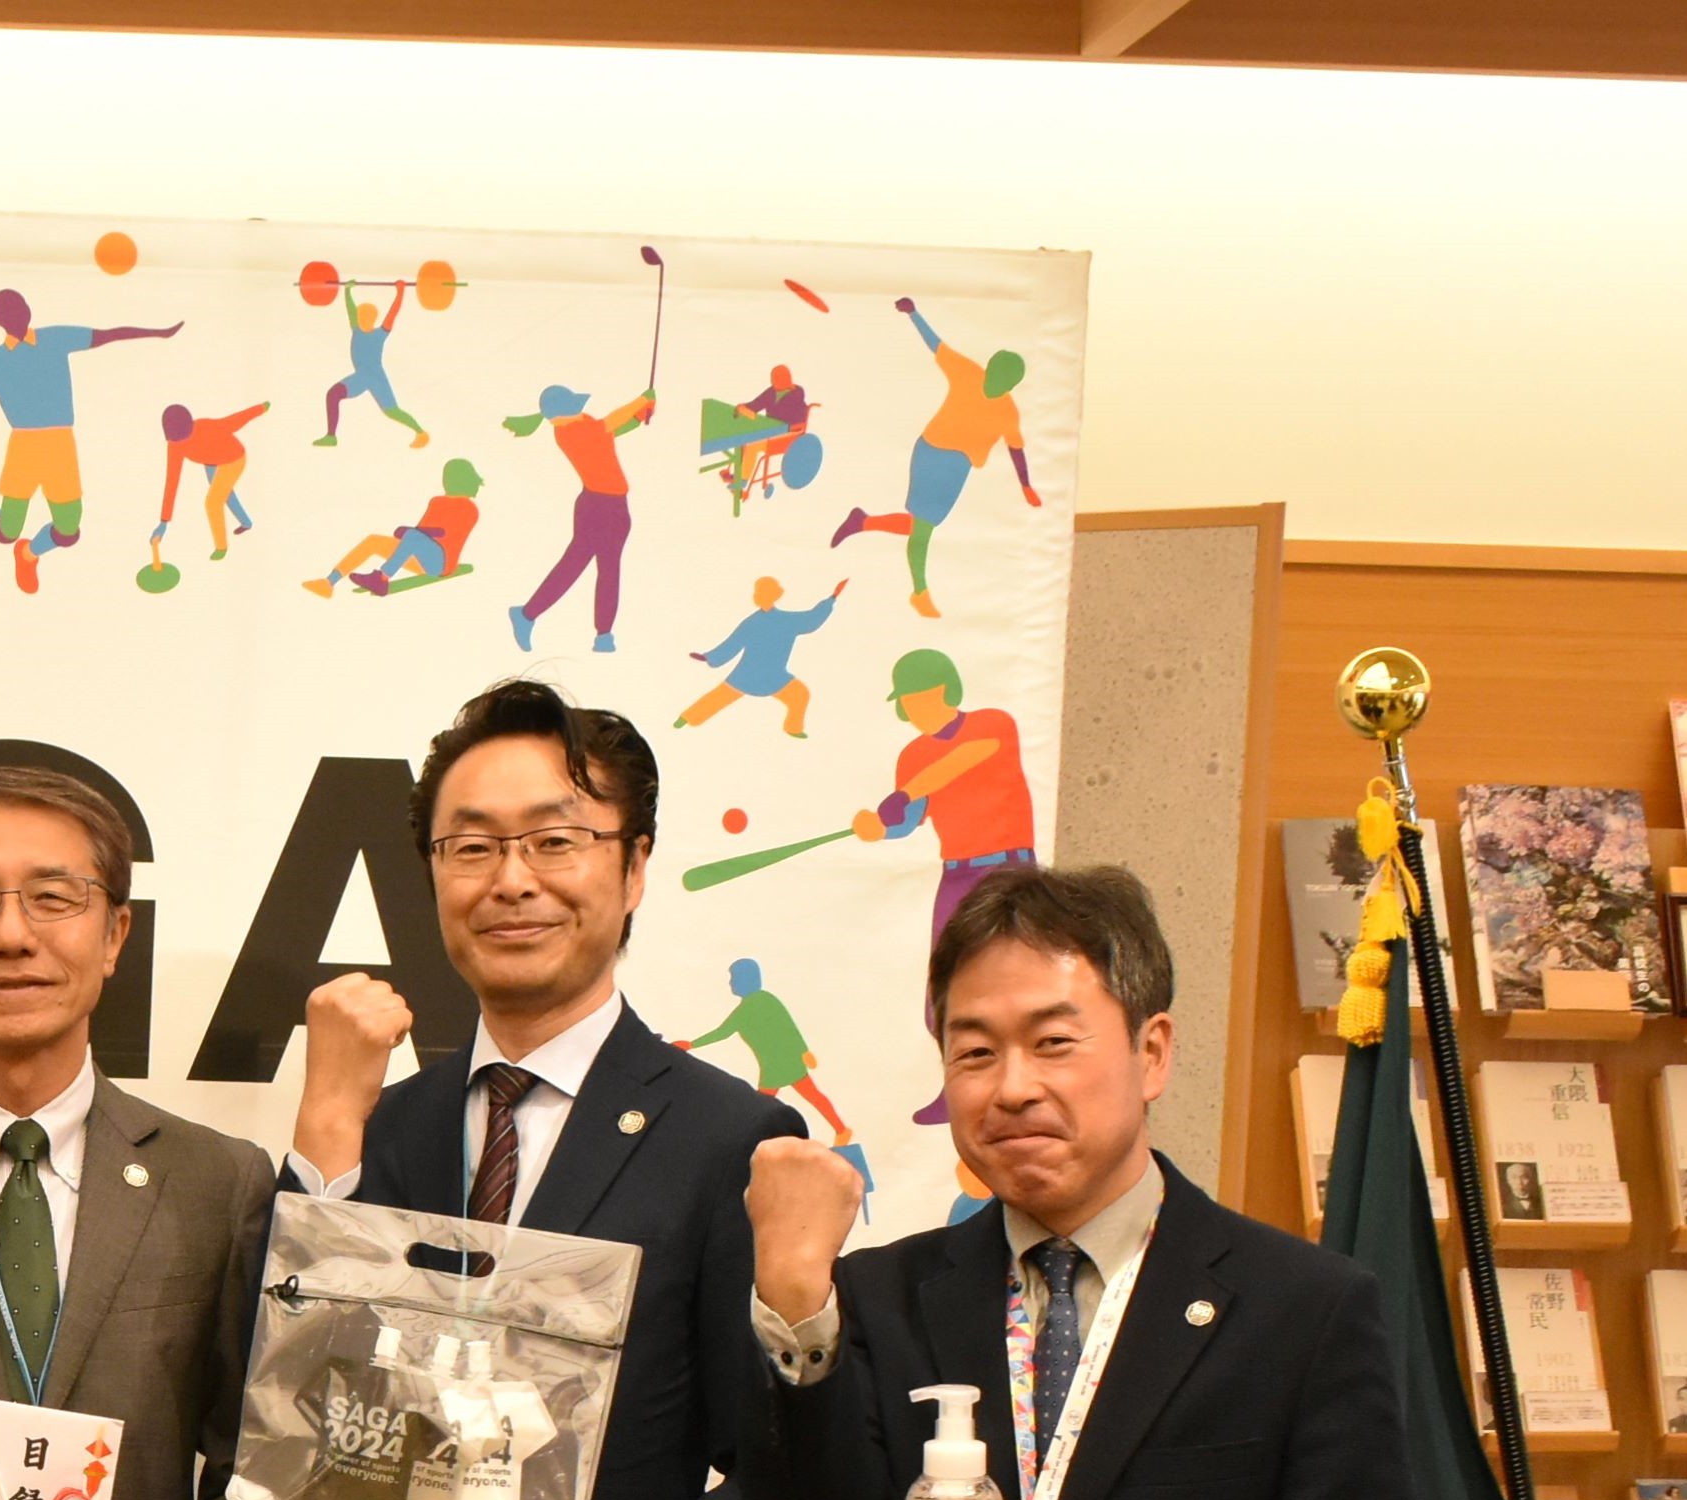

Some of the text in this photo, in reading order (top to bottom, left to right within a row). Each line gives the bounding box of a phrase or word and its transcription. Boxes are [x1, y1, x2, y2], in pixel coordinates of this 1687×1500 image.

[327, 1396, 408, 1437] SAGA
[325, 1419, 404, 1463] 2024
[412, 1475, 453, 1492] ryone.
[463, 1476, 512, 1488] eryone.
